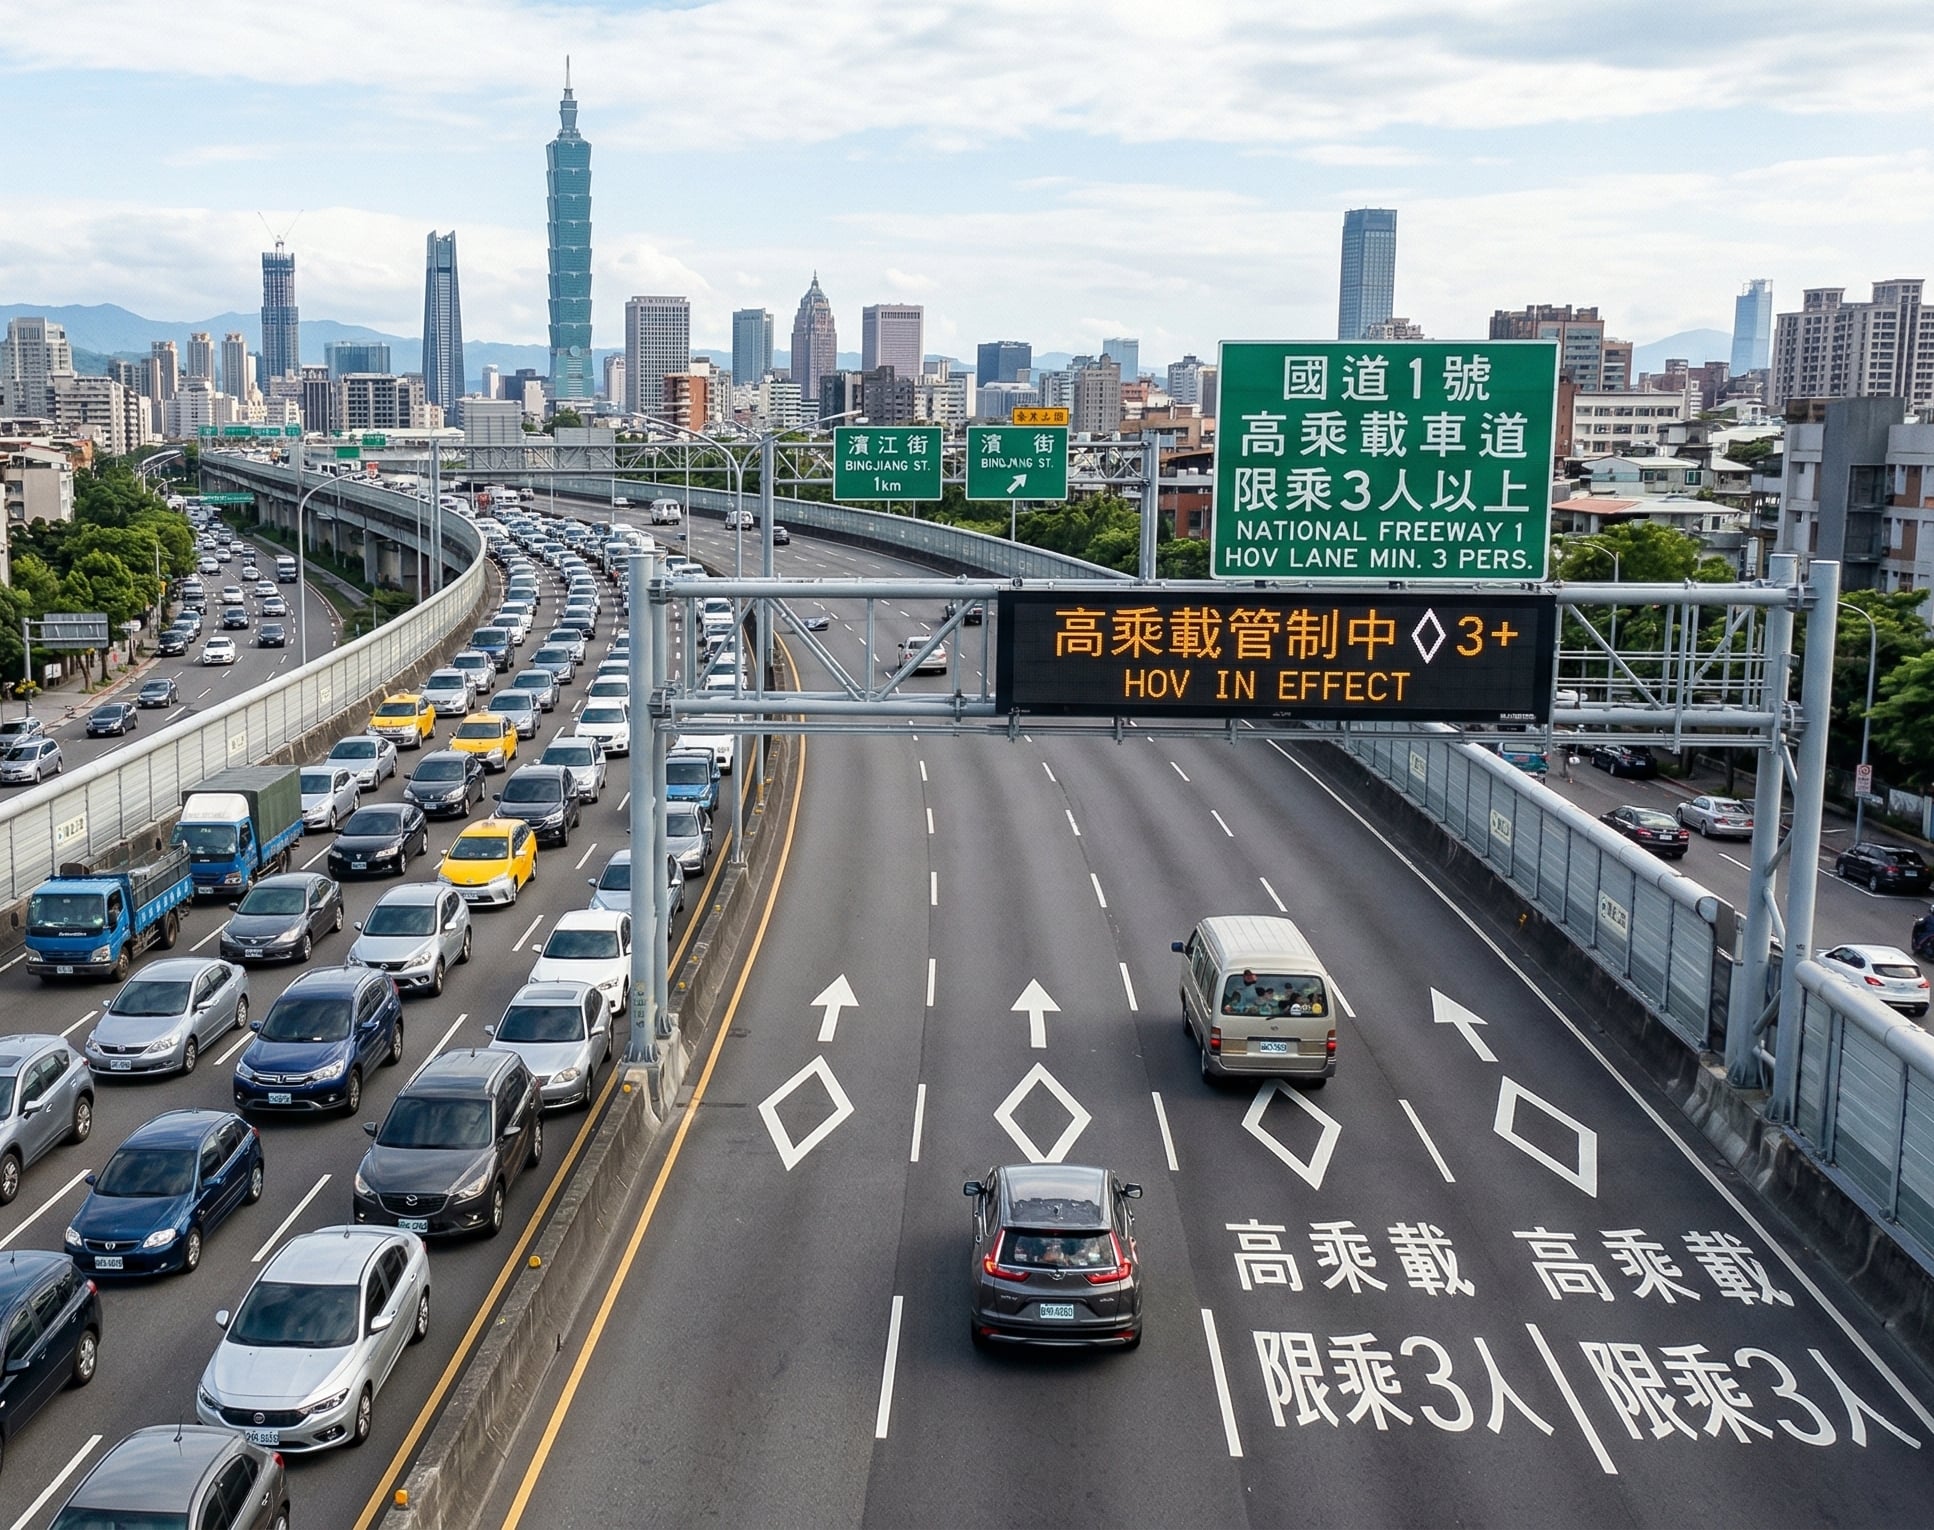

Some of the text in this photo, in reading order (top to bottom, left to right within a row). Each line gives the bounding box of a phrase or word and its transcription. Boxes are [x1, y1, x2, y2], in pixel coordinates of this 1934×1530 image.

[1283, 354, 1491, 401] 國道1號
[849, 434, 929, 456] 濱江街
[1241, 410, 1528, 458] 高乘載車道
[845, 460, 931, 471] BINGJIANG ST.
[1038, 458, 1054, 469] ST.
[1234, 467, 1530, 513] 限乘3人以上
[1237, 520, 1523, 543] NATIONAL FREEWAY 1
[1225, 547, 1533, 570] HOV LANE MIN. 3 PERS.
[1055, 606, 1519, 661] 高乘載管制中 3+
[1124, 668, 1411, 702] HOV IN EFFECT
[1226, 1219, 1476, 1297] 高乘載
[1512, 1226, 1795, 1308] 高乘載
[1252, 1329, 1555, 1437] 限乘3人
[1577, 1340, 1922, 1449] 限乘3人
